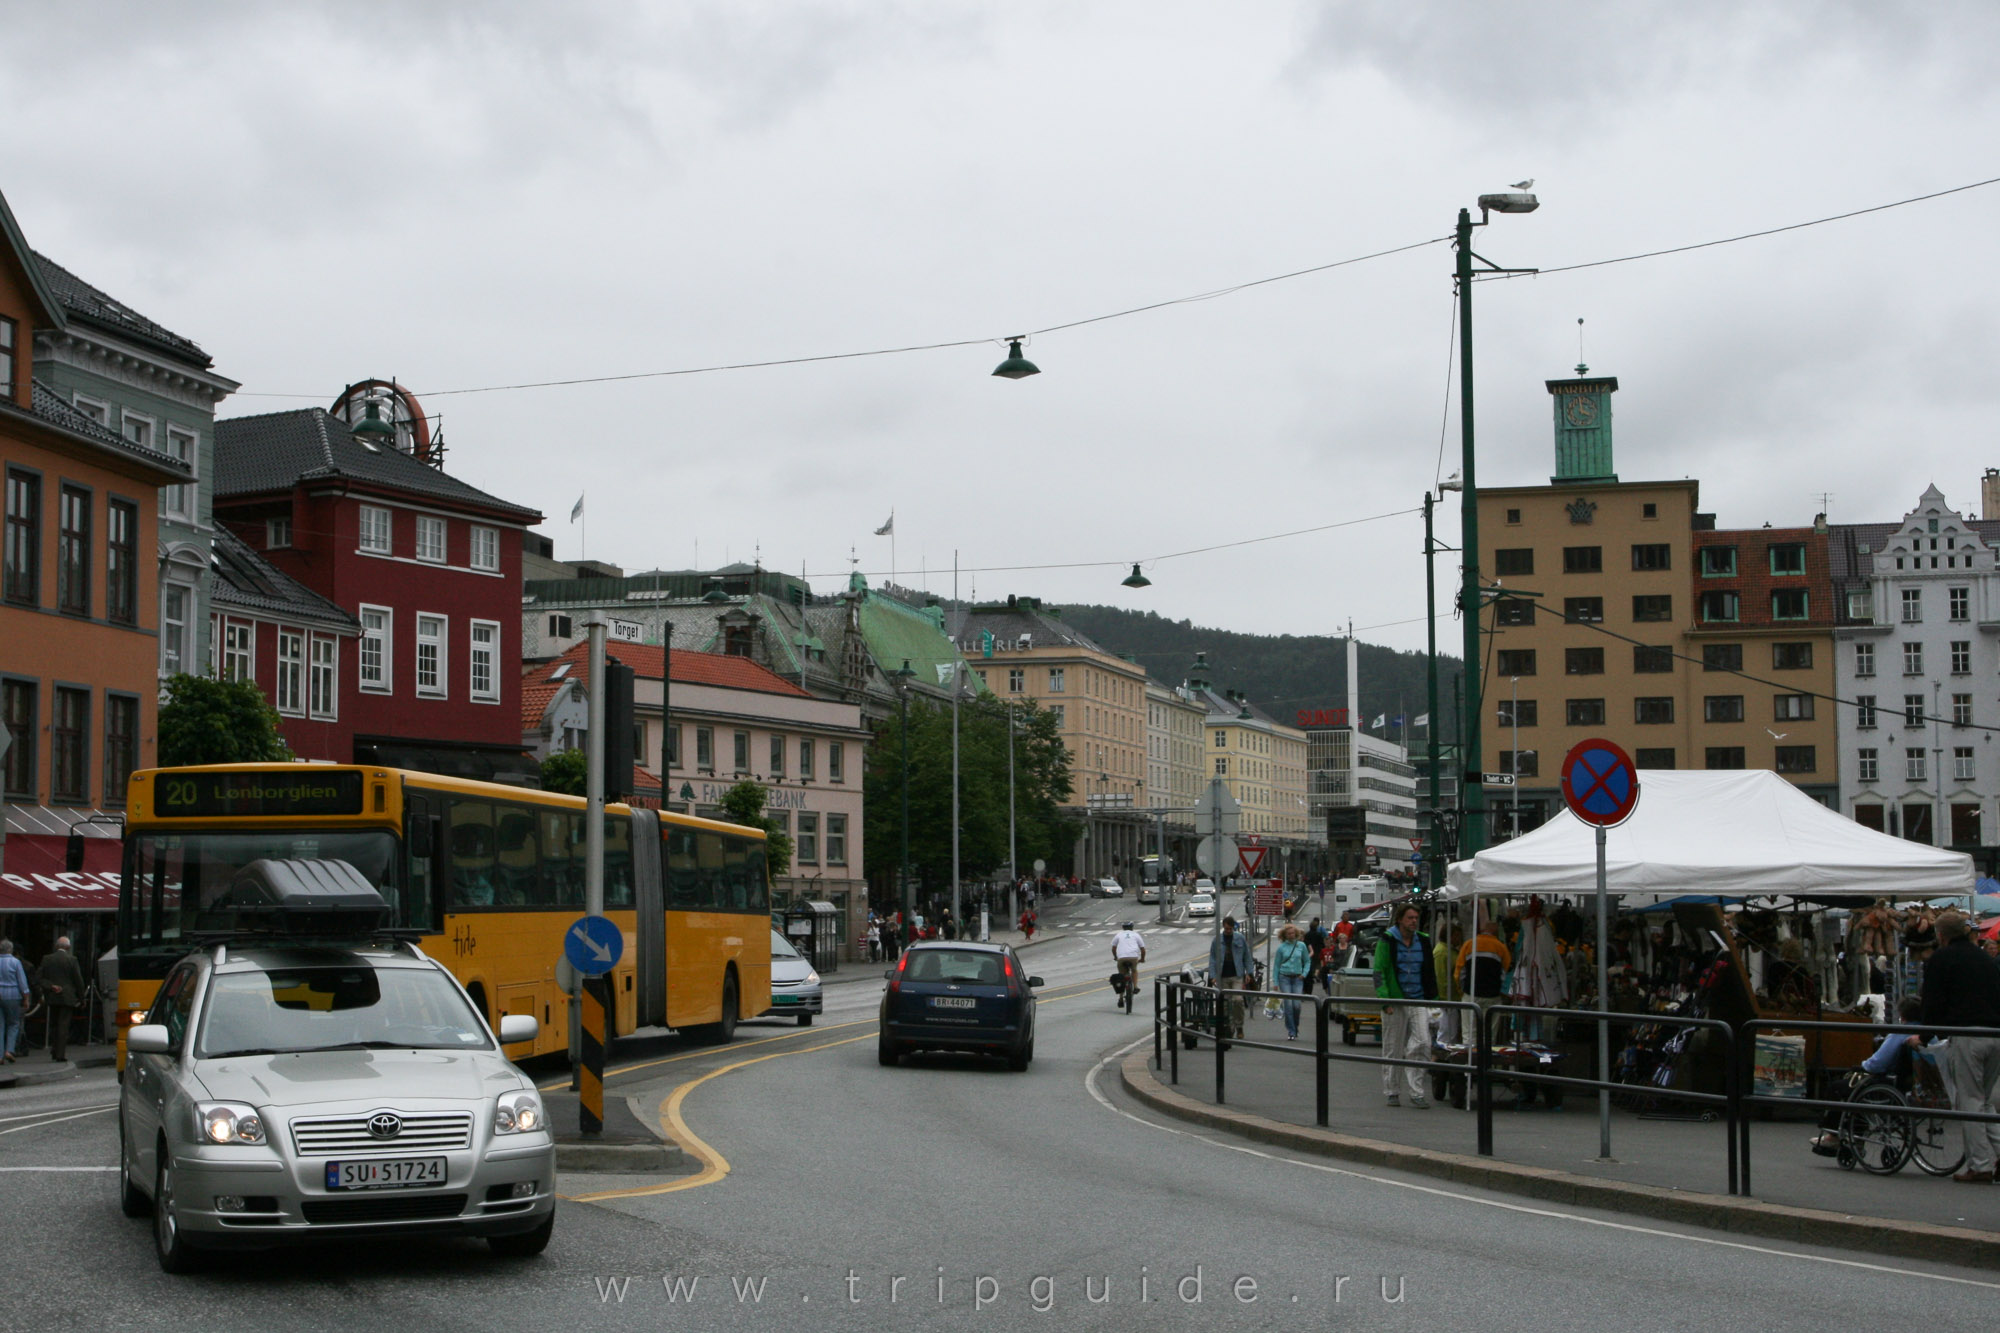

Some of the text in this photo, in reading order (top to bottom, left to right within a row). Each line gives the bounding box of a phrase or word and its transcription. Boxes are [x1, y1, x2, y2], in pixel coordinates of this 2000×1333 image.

[1553, 384, 1609, 394] HARBITZ
[613, 620, 639, 640] Torget
[1297, 707, 1349, 726] SUNDT
[166, 780, 338, 805] 20 Lønborglien
[453, 924, 476, 958] tide
[345, 1162, 439, 1183] SU 51724
